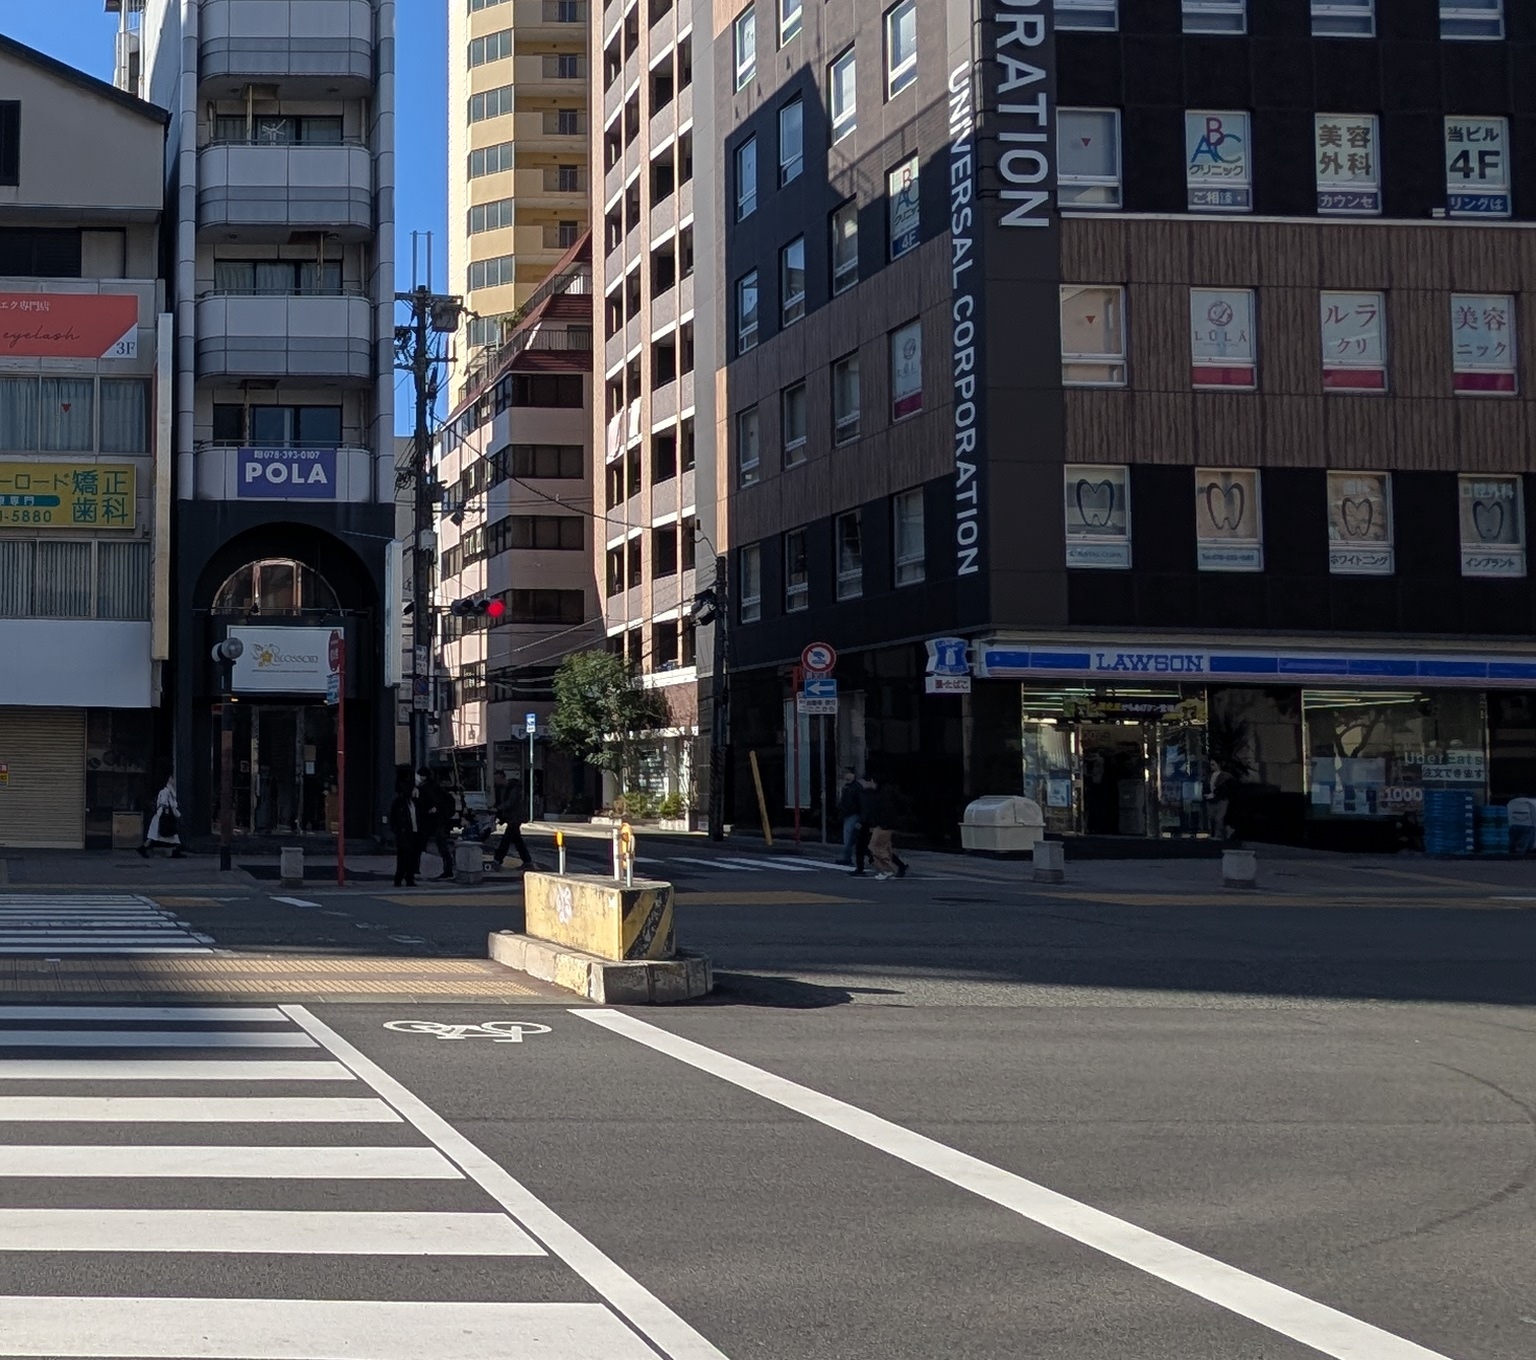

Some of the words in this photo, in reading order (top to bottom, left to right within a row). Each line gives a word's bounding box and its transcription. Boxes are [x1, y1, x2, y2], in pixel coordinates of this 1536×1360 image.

[1319, 124, 1371, 149] 美容
[1447, 126, 1499, 142] 当ビル
[949, 60, 973, 290] UNIVERSAL
[1189, 164, 1244, 177] クリニック
[1319, 151, 1372, 176] 外科
[1449, 150, 1501, 179] 4F
[1319, 194, 1373, 209] カウンセ
[1450, 197, 1504, 211] リングは
[1324, 304, 1377, 327] ルラ
[1456, 306, 1506, 331] 美容
[3, 325, 81, 348] eyelash
[116, 342, 135, 355] 3F
[953, 295, 980, 577] CORPORATION
[72, 469, 128, 496] 矯正
[245, 462, 328, 483] POLA
[72, 497, 128, 524] 歯科
[1096, 653, 1204, 672] LAWSON
